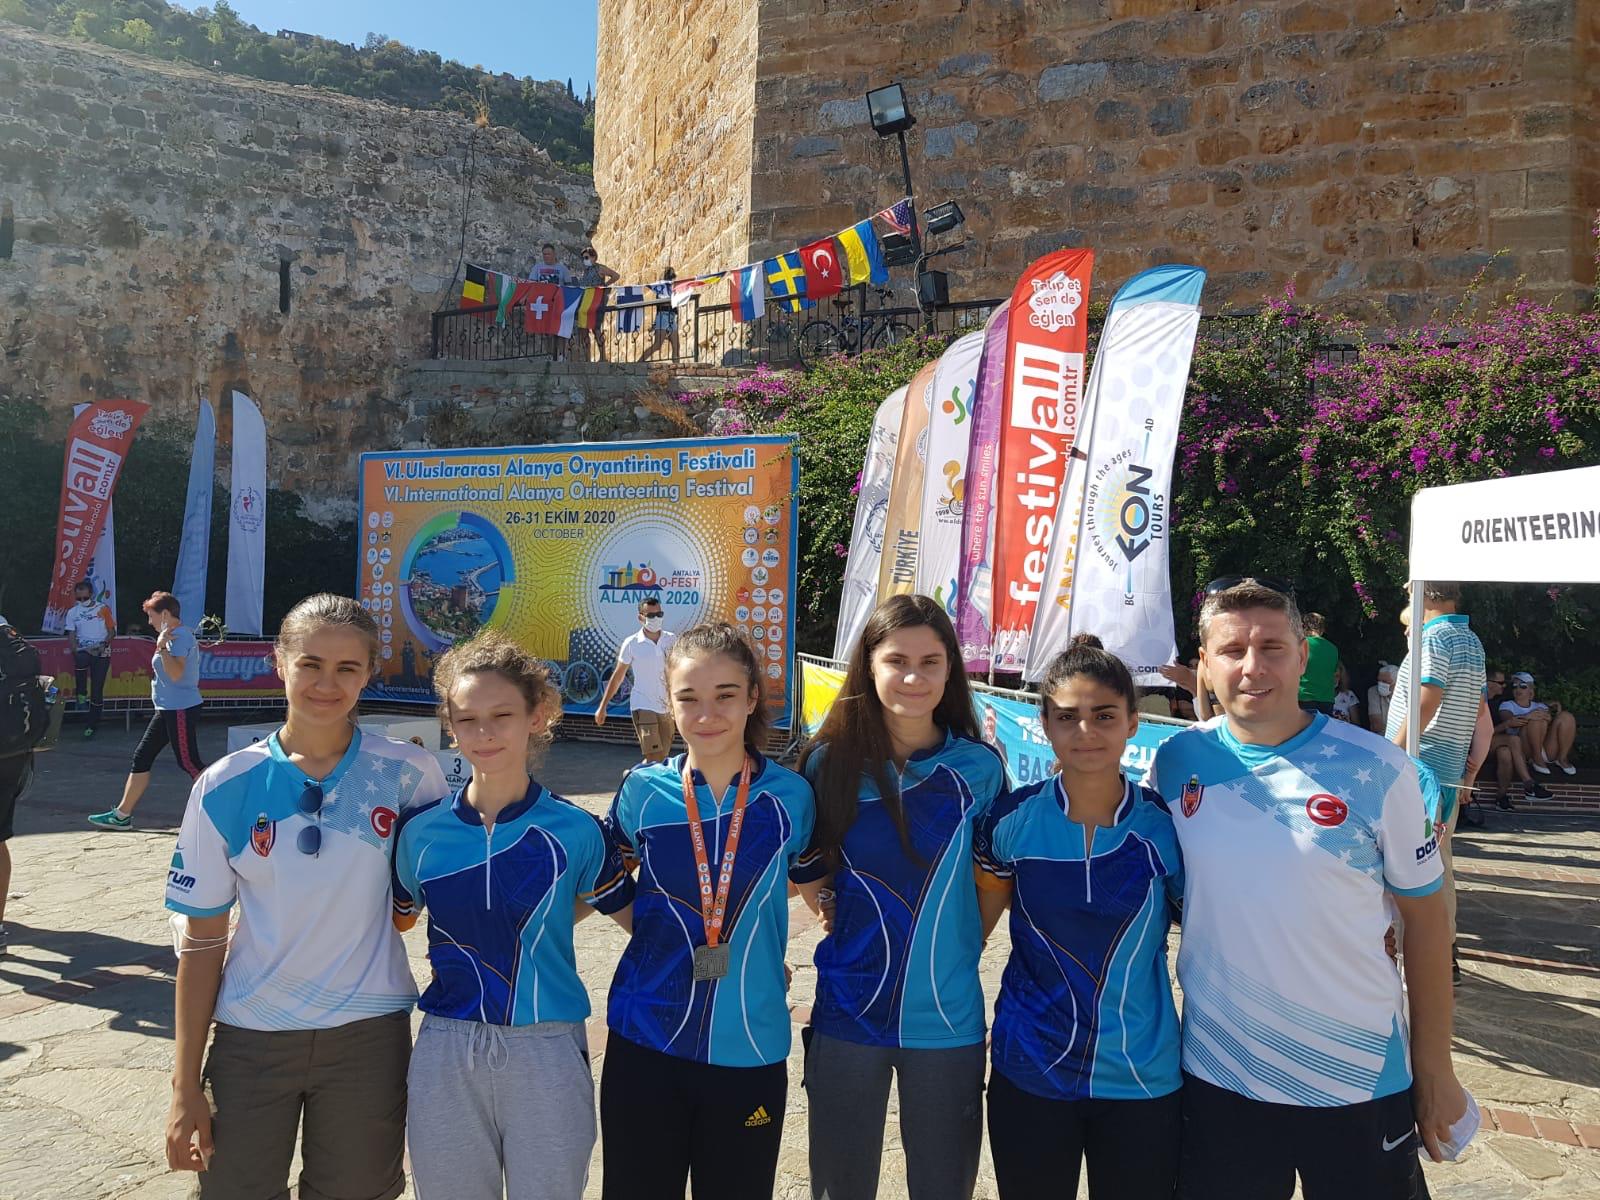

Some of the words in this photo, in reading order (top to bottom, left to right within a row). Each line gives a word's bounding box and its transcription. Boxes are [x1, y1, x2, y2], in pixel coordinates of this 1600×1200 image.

[1061, 293, 1076, 304] de
[1145, 418, 1154, 432] AD
[505, 457, 564, 480] Alanya
[568, 454, 673, 479] Oryantiring
[678, 448, 756, 471] Festivali
[1096, 464, 1110, 481] the
[508, 480, 564, 504] Alanya
[569, 479, 680, 502] Orienteering
[686, 475, 754, 498] Festival
[978, 480, 987, 500] sun
[505, 511, 539, 524] 26-31
[544, 508, 579, 525] EKİM
[584, 510, 616, 524] 2020
[976, 503, 984, 522] the
[1150, 493, 1164, 539] TOURS
[533, 528, 585, 539] OCTOBER
[1461, 510, 1600, 544] ORIENTEERIN
[972, 526, 982, 560] where
[890, 529, 919, 584] TÜRKİYE
[659, 577, 699, 588] O-FEST
[666, 590, 699, 605] 2020
[1125, 593, 1134, 606] BC
[454, 758, 461, 774] 3
[731, 807, 743, 839] ALANYA
[745, 1116, 771, 1127] adidas
